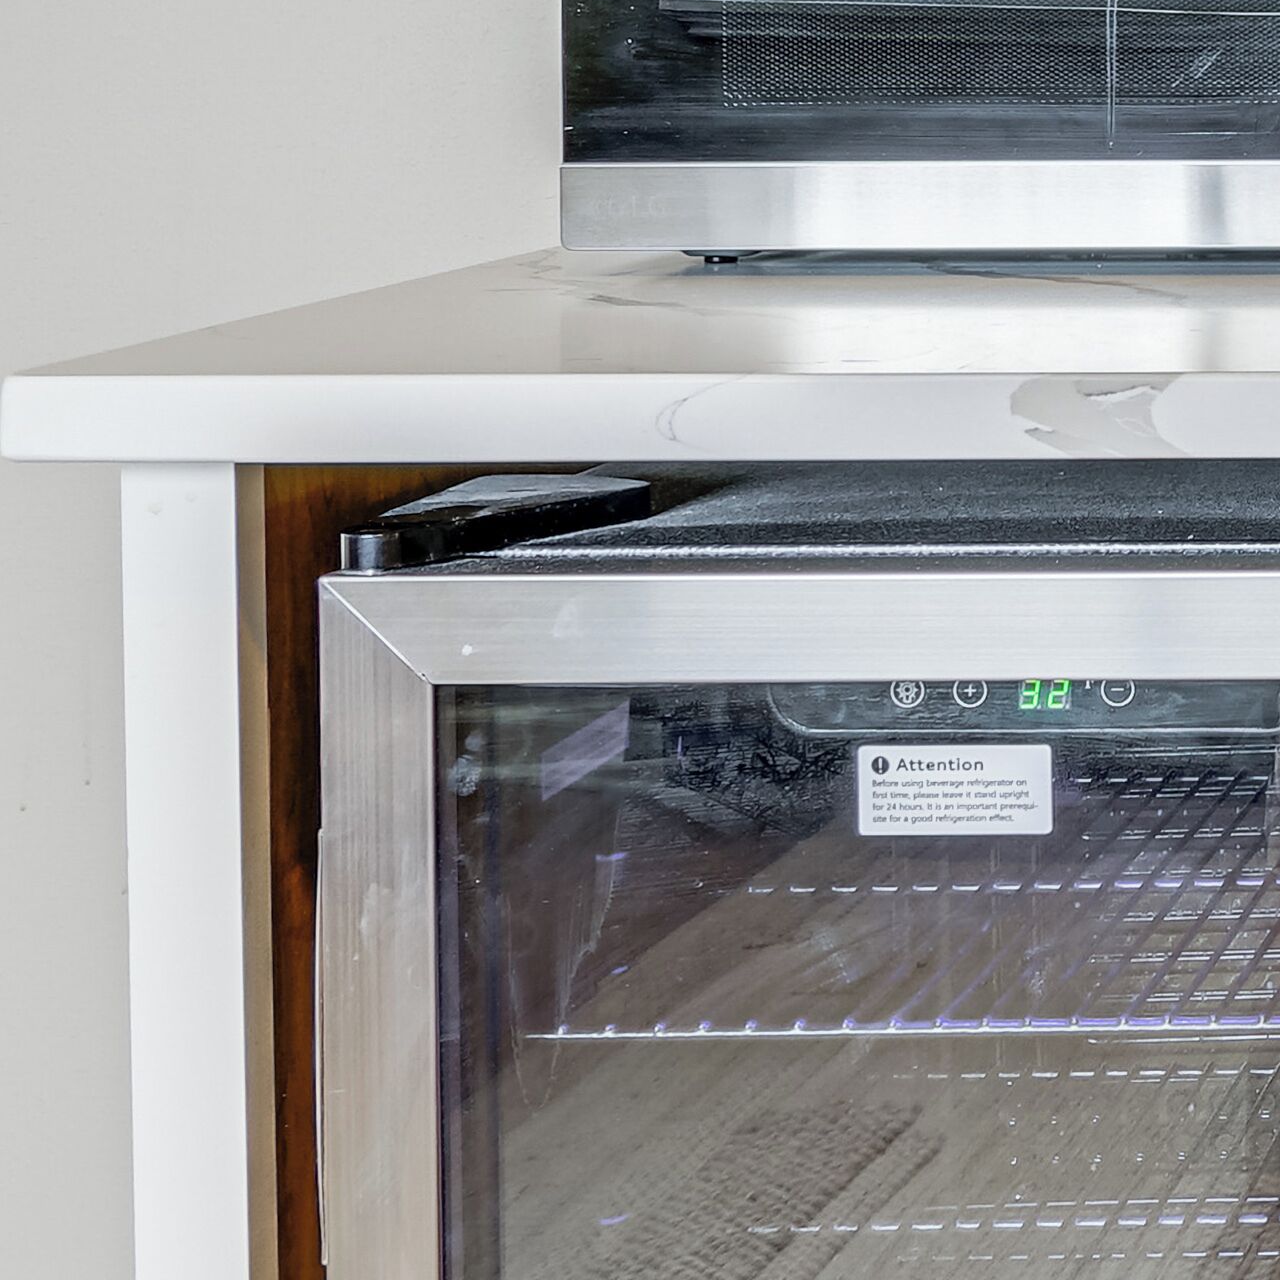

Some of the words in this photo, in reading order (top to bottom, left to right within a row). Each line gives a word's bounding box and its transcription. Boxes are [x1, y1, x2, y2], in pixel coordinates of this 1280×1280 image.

[1019, 679, 1070, 709] 32
[896, 758, 984, 771] Attention
[901, 780, 923, 788] using
[926, 780, 964, 789] beverage
[966, 779, 1014, 789] refrigerator
[913, 791, 939, 800] please
[999, 790, 1029, 800] upright
[872, 803, 884, 811] for
[886, 803, 897, 811] 24
[956, 803, 998, 811] important
[889, 814, 901, 822] for
[911, 814, 933, 824] good
[935, 814, 987, 824] refrigeration
